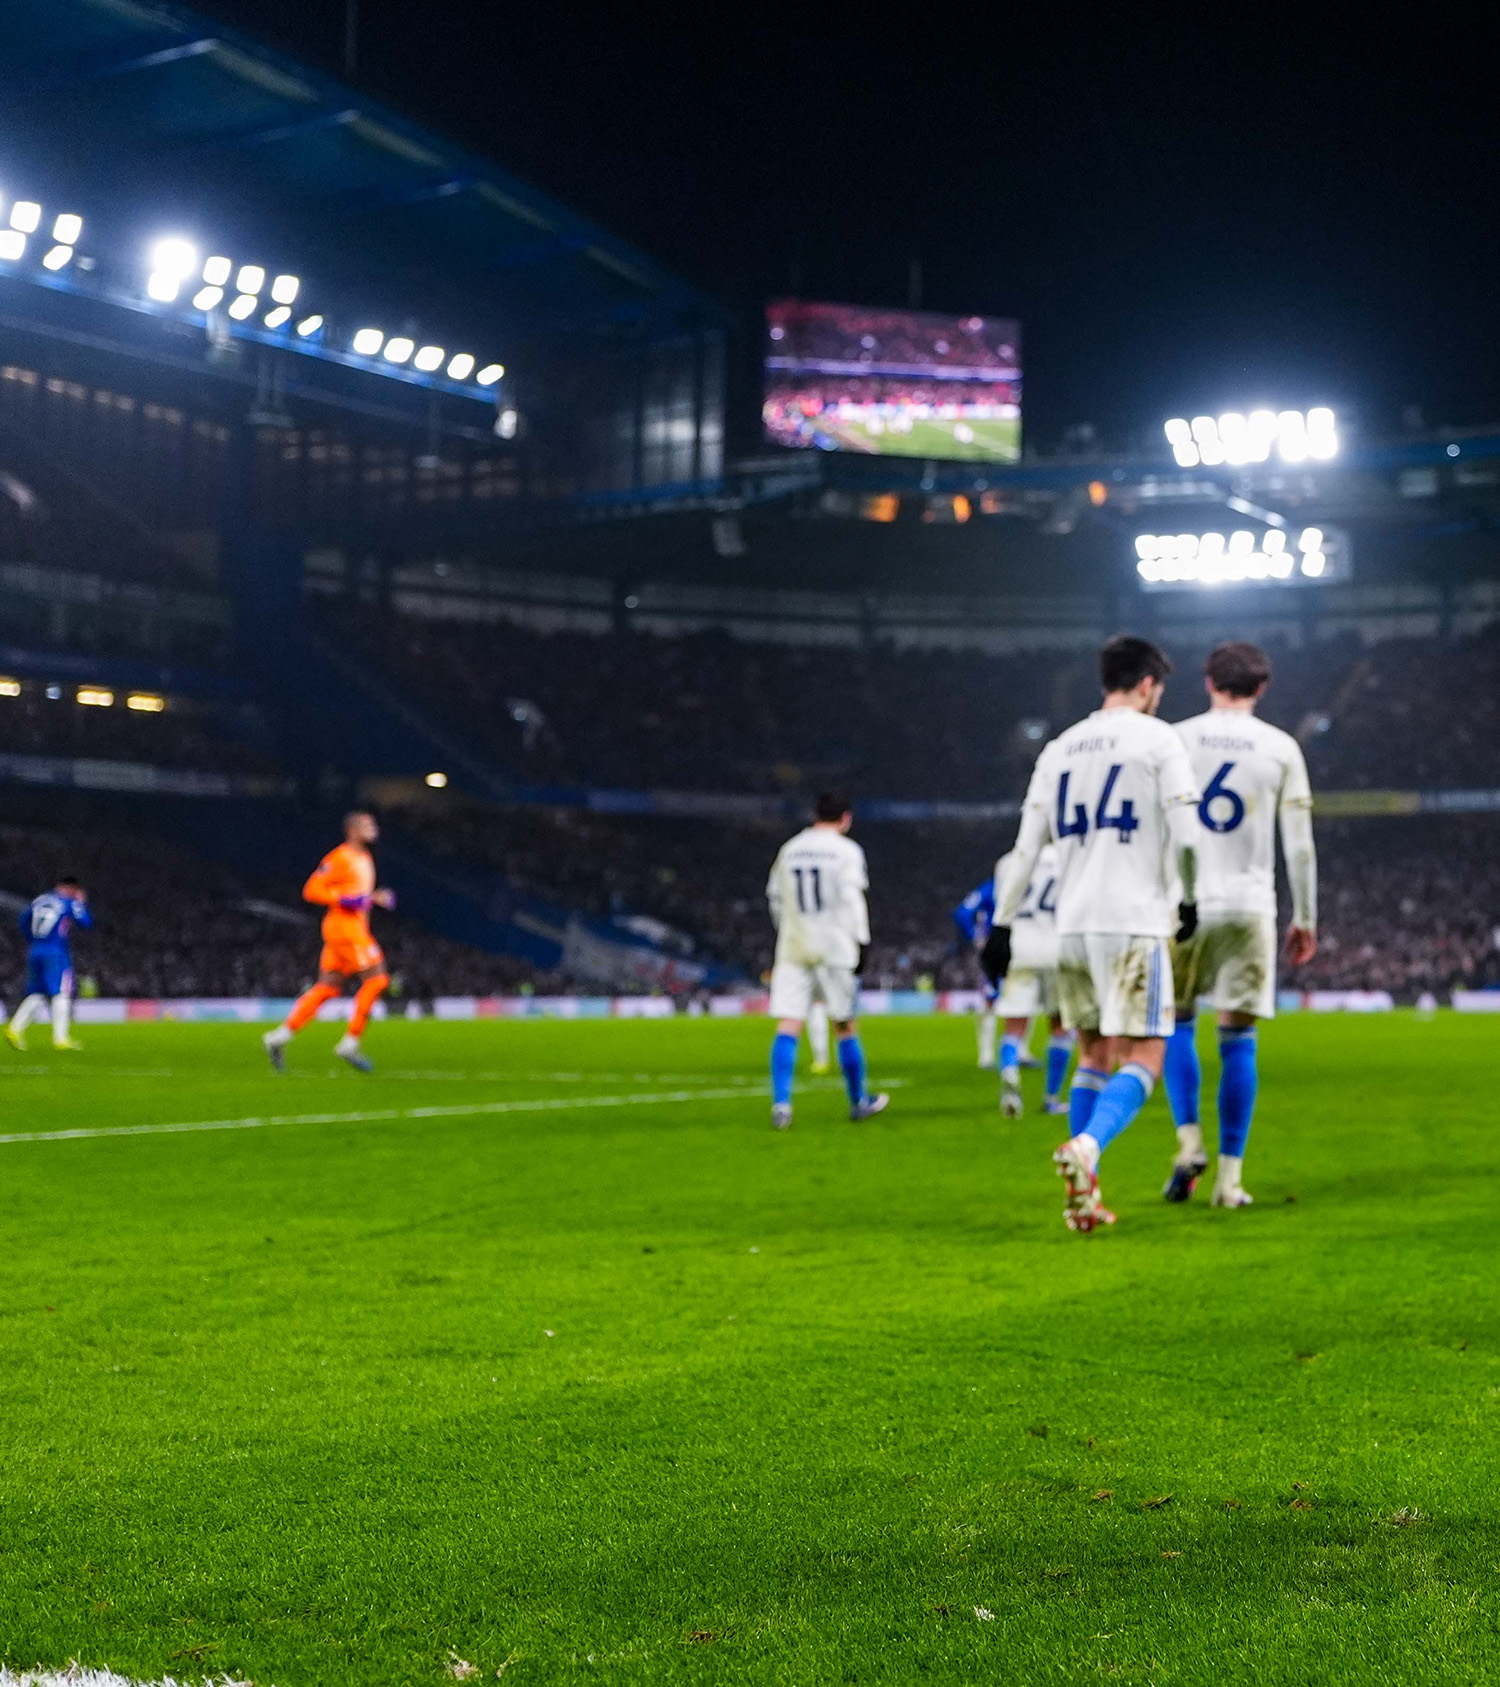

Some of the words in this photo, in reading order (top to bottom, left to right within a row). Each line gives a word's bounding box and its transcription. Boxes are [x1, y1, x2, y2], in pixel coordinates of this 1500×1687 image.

[1057, 763, 1140, 845] 44
[1198, 761, 1245, 833] 6
[790, 866, 824, 912] 11
